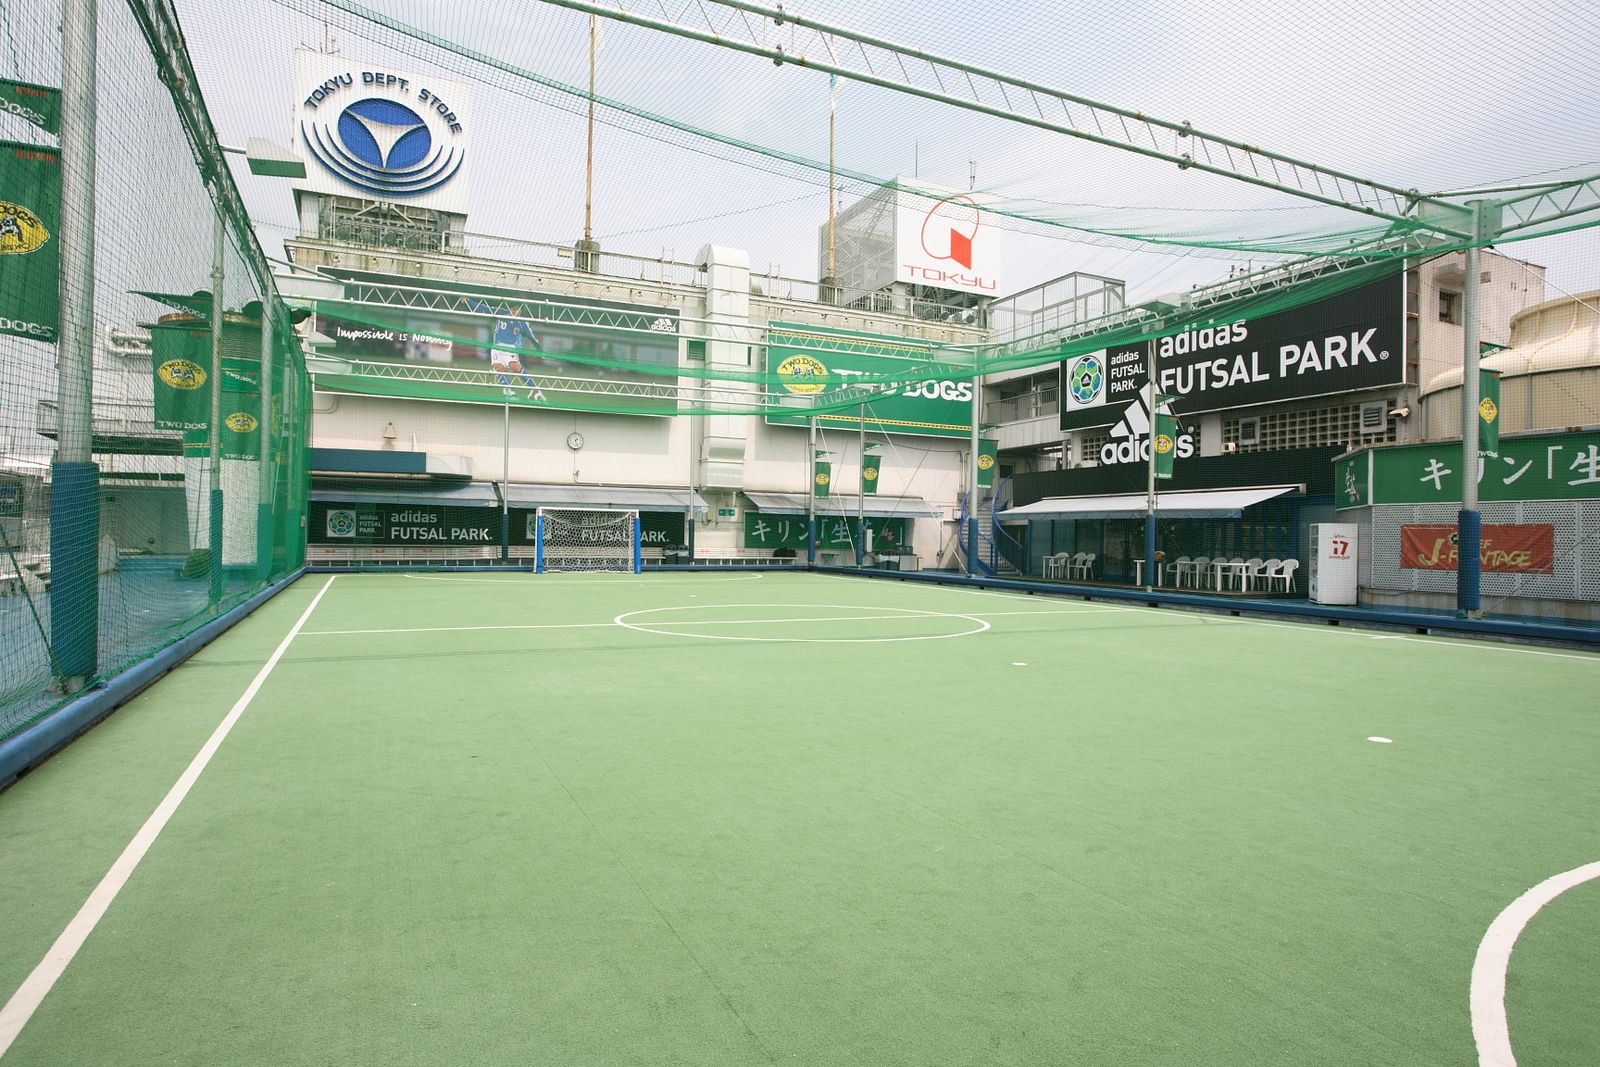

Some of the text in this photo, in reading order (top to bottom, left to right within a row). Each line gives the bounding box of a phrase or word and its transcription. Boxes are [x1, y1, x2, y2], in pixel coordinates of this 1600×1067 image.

[304, 72, 462, 135] TOKYU DEPT. STORE
[903, 265, 996, 290] TOKYU
[0, 317, 53, 337] DOGS
[337, 327, 394, 341] Impossible
[1160, 319, 1247, 358] adidas
[781, 357, 824, 374] TWO DOGS
[1111, 350, 1139, 365] adidas
[1111, 362, 1145, 377] FUTSAL
[1160, 351, 1269, 395] FUTSAL
[903, 380, 973, 401] DOGS
[1101, 431, 1194, 465] adis
[390, 510, 438, 523] adidas
[391, 527, 447, 540] FUTSAL
[640, 531, 669, 542] ARK.
